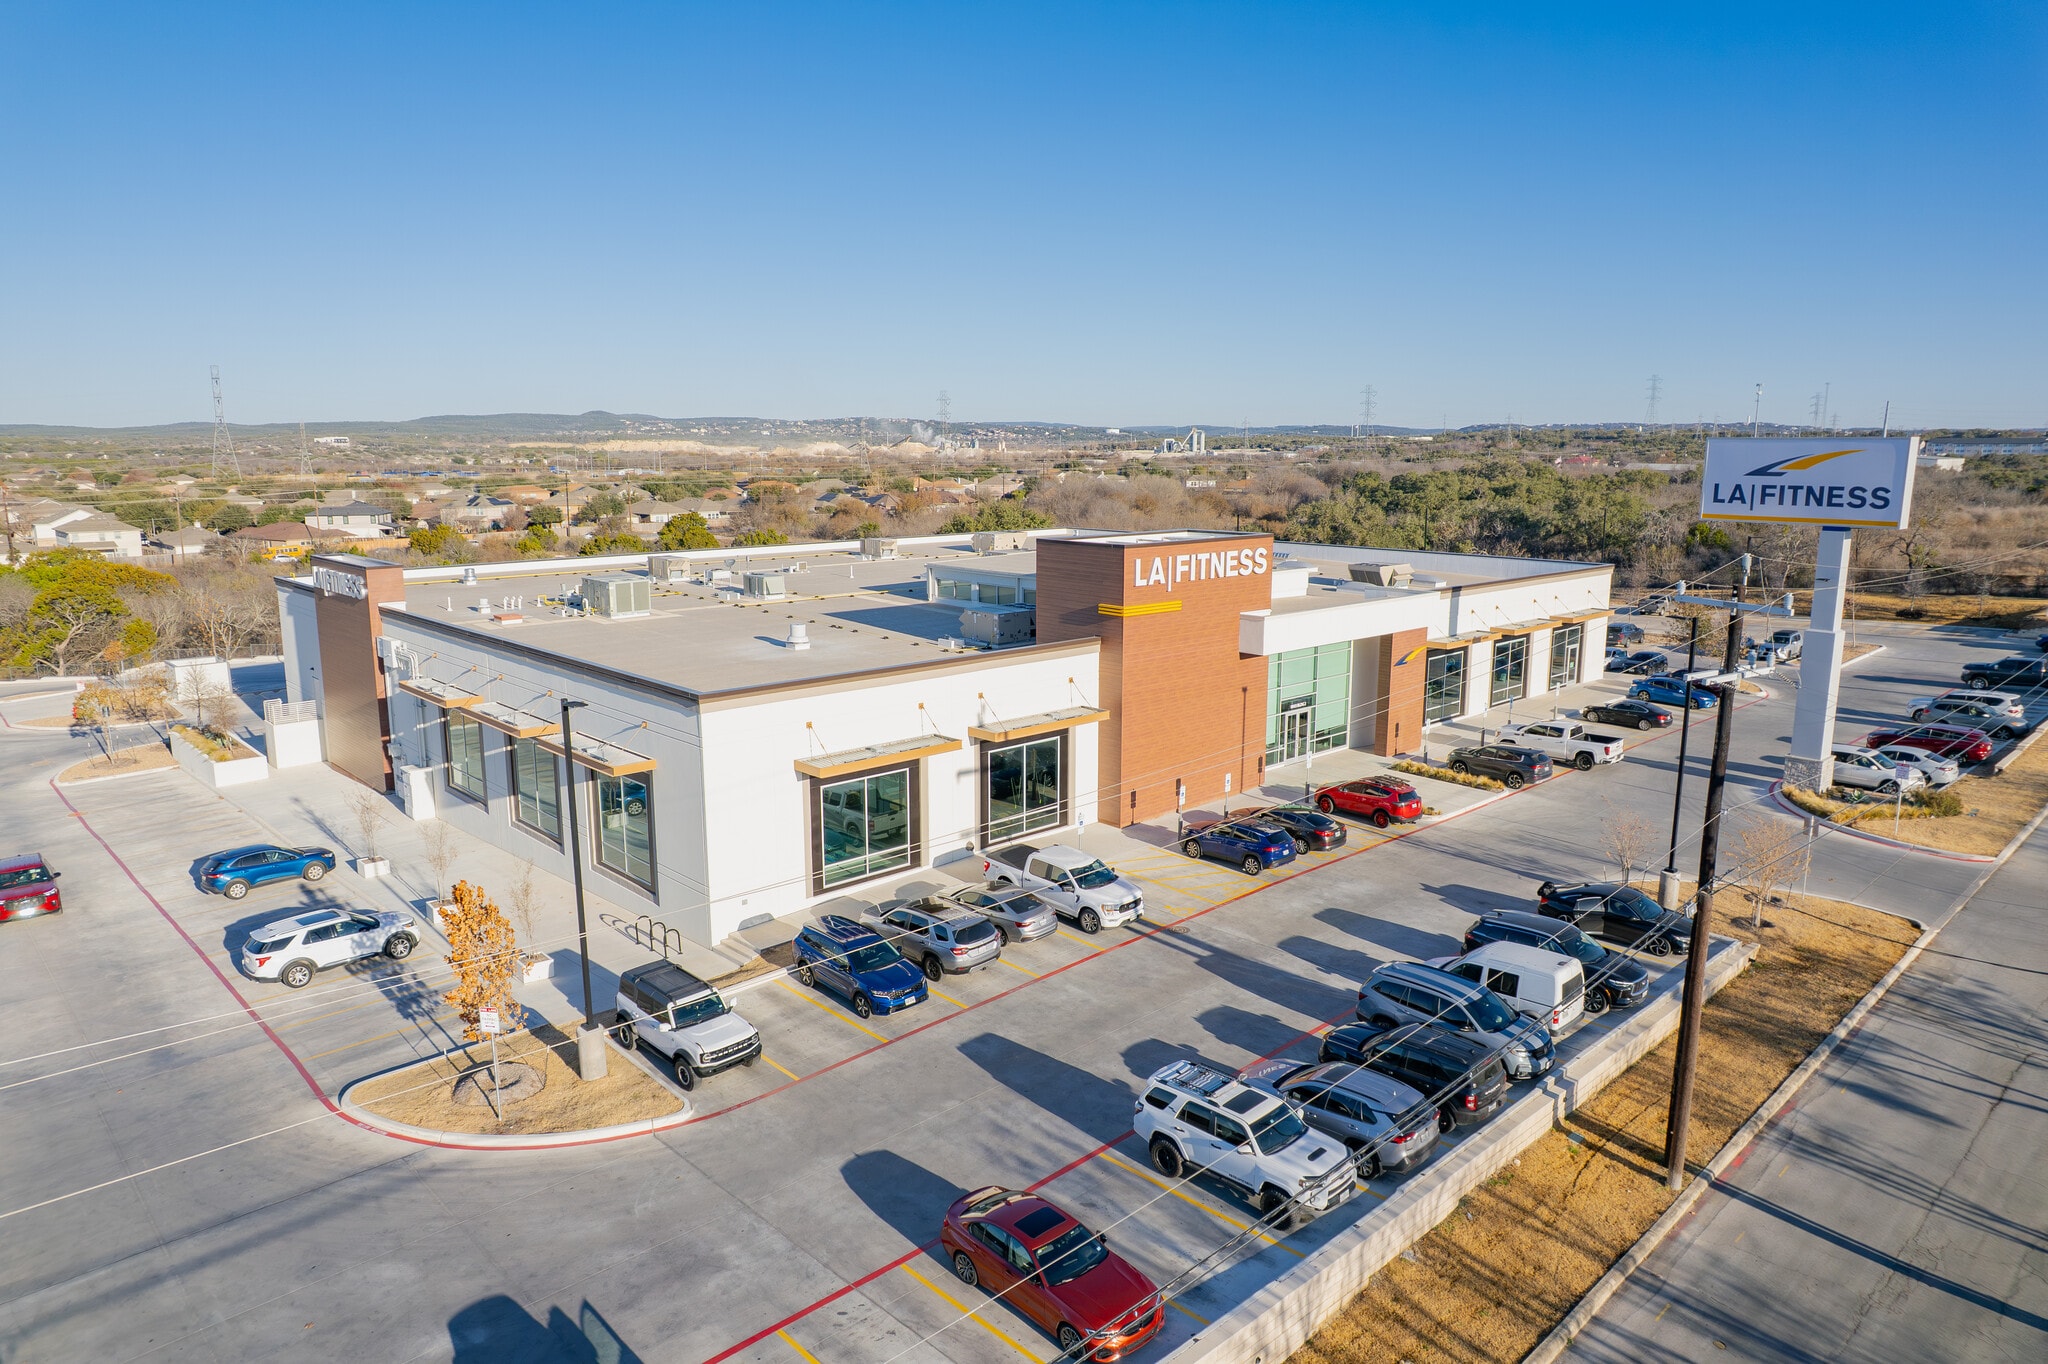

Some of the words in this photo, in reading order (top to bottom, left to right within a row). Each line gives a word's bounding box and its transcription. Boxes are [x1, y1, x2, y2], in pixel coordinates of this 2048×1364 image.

[1712, 483, 1747, 504] LA
[1759, 484, 1892, 510] FITNESS
[1134, 556, 1166, 587] LA
[1175, 547, 1268, 583] FITNESS
